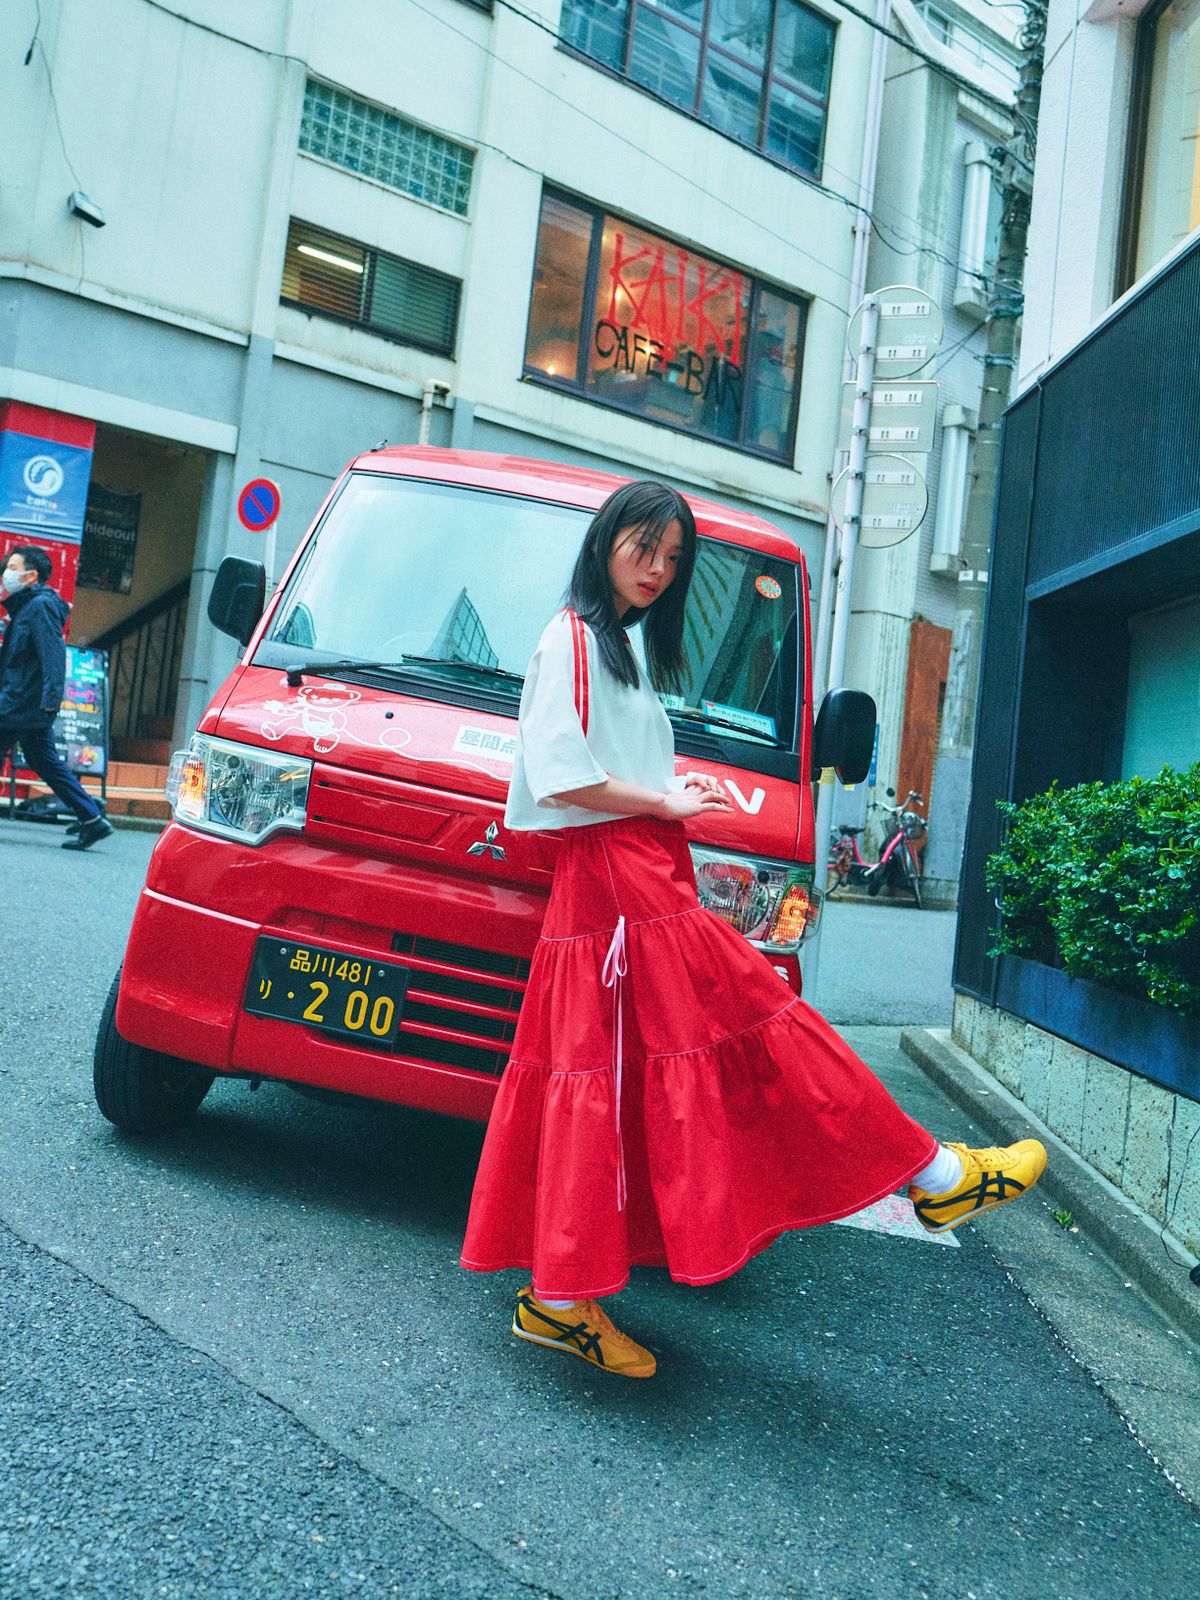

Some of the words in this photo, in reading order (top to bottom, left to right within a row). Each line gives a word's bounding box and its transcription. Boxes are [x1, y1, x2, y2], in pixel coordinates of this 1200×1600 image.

[608, 233, 743, 368] KAIKI
[595, 319, 742, 411] CAFE-BAR
[85, 520, 135, 543] hideout
[460, 729, 517, 755] 昼間点
